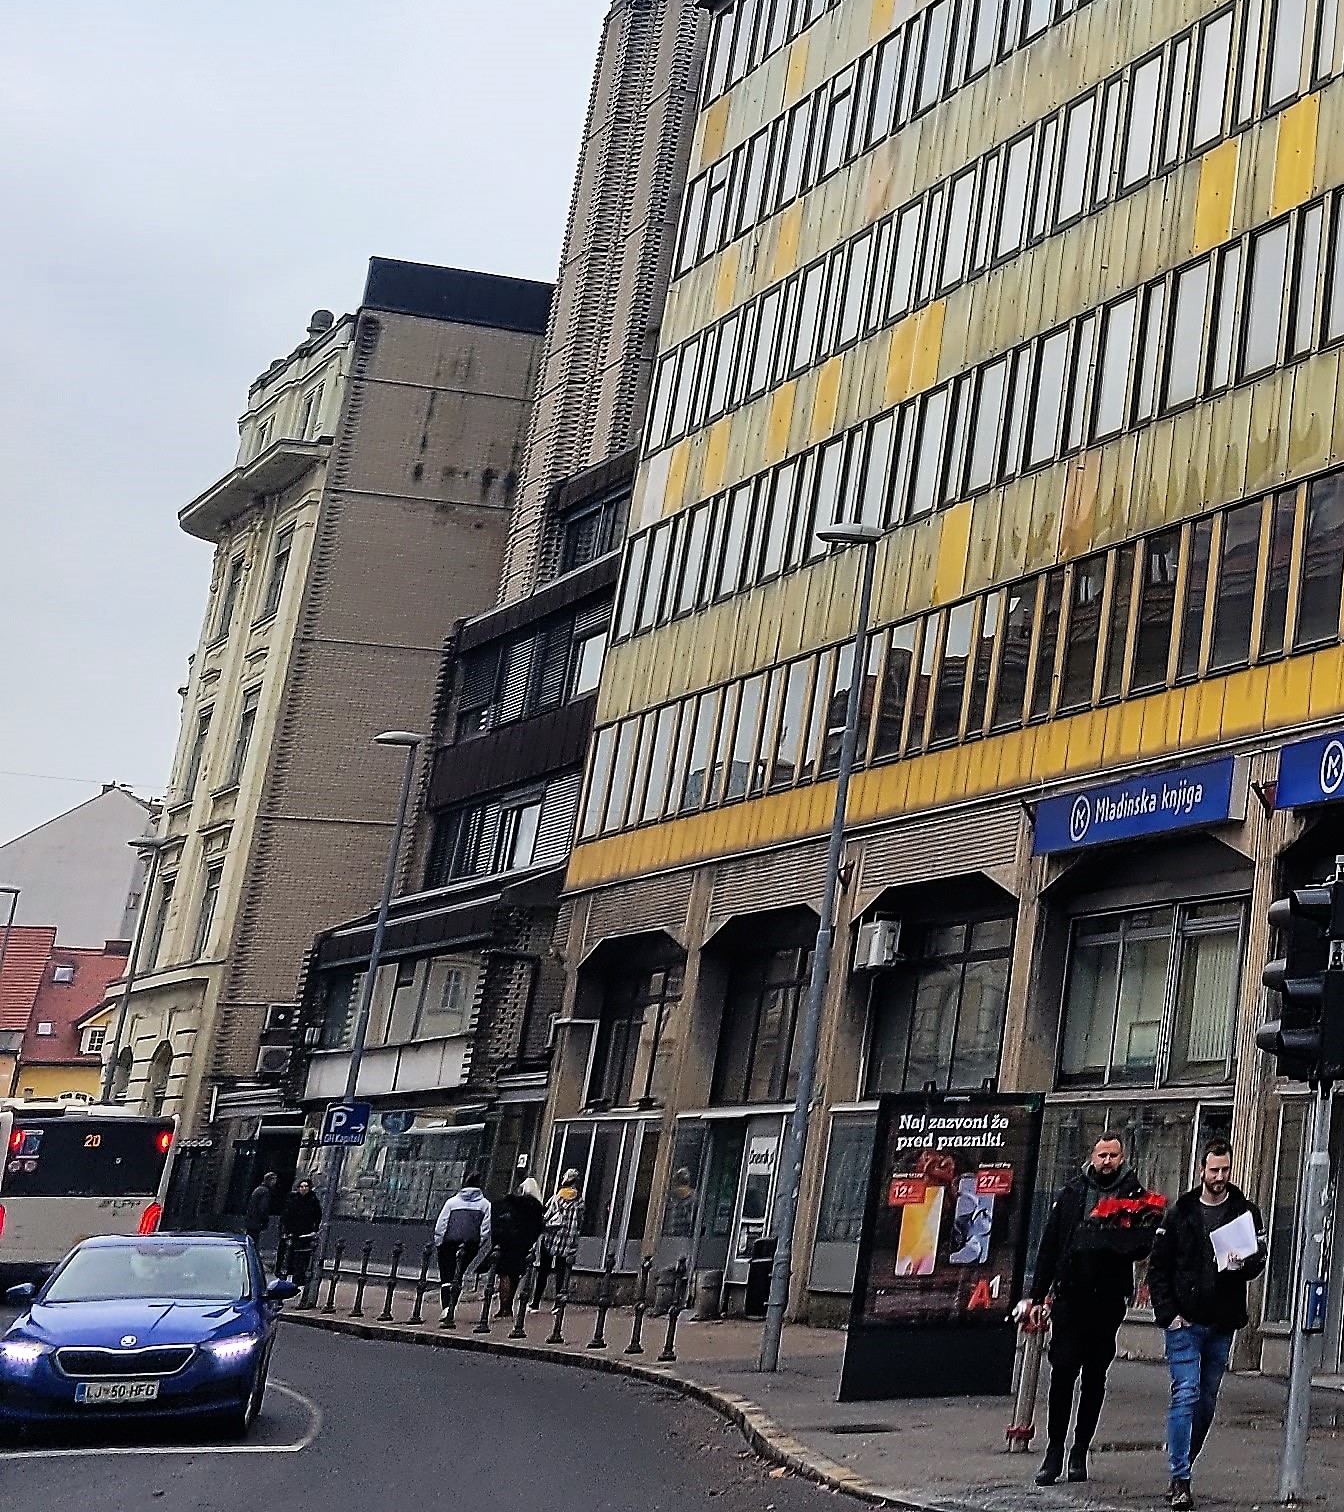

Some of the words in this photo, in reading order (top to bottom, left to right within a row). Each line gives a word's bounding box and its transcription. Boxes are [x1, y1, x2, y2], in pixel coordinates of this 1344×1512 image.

[1094, 787, 1157, 824] Mladinska
[1160, 779, 1203, 816] knjiga
[329, 1111, 348, 1133] P
[899, 1114, 926, 1133] Naj
[928, 1114, 988, 1130] zazvoni
[991, 1113, 1009, 1129] že
[83, 1134, 101, 1147] 20
[896, 1132, 934, 1151] pred
[936, 1132, 1006, 1151] prazniki.
[967, 1273, 1001, 1310] A1
[86, 1385, 102, 1399] LJ
